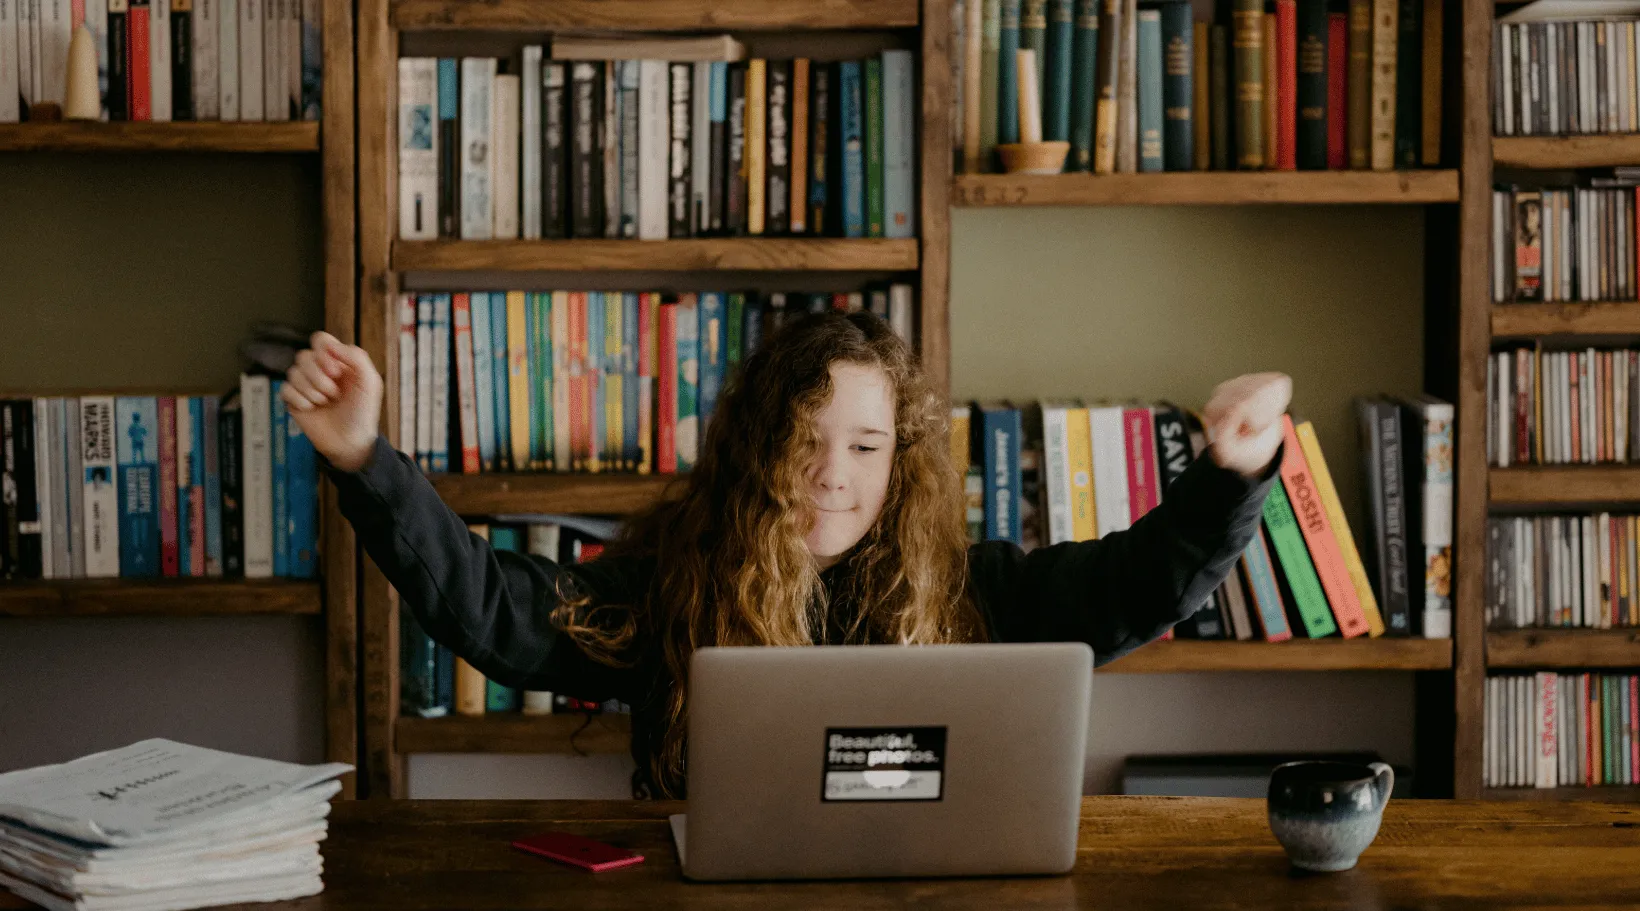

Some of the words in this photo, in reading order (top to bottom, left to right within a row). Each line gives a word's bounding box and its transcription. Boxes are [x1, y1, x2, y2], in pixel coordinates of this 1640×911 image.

[84, 404, 99, 461] MARKS
[1160, 421, 1188, 484] SAV
[828, 749, 867, 764] free
[867, 750, 939, 767] photos.
[829, 733, 918, 750] Beautiful,
